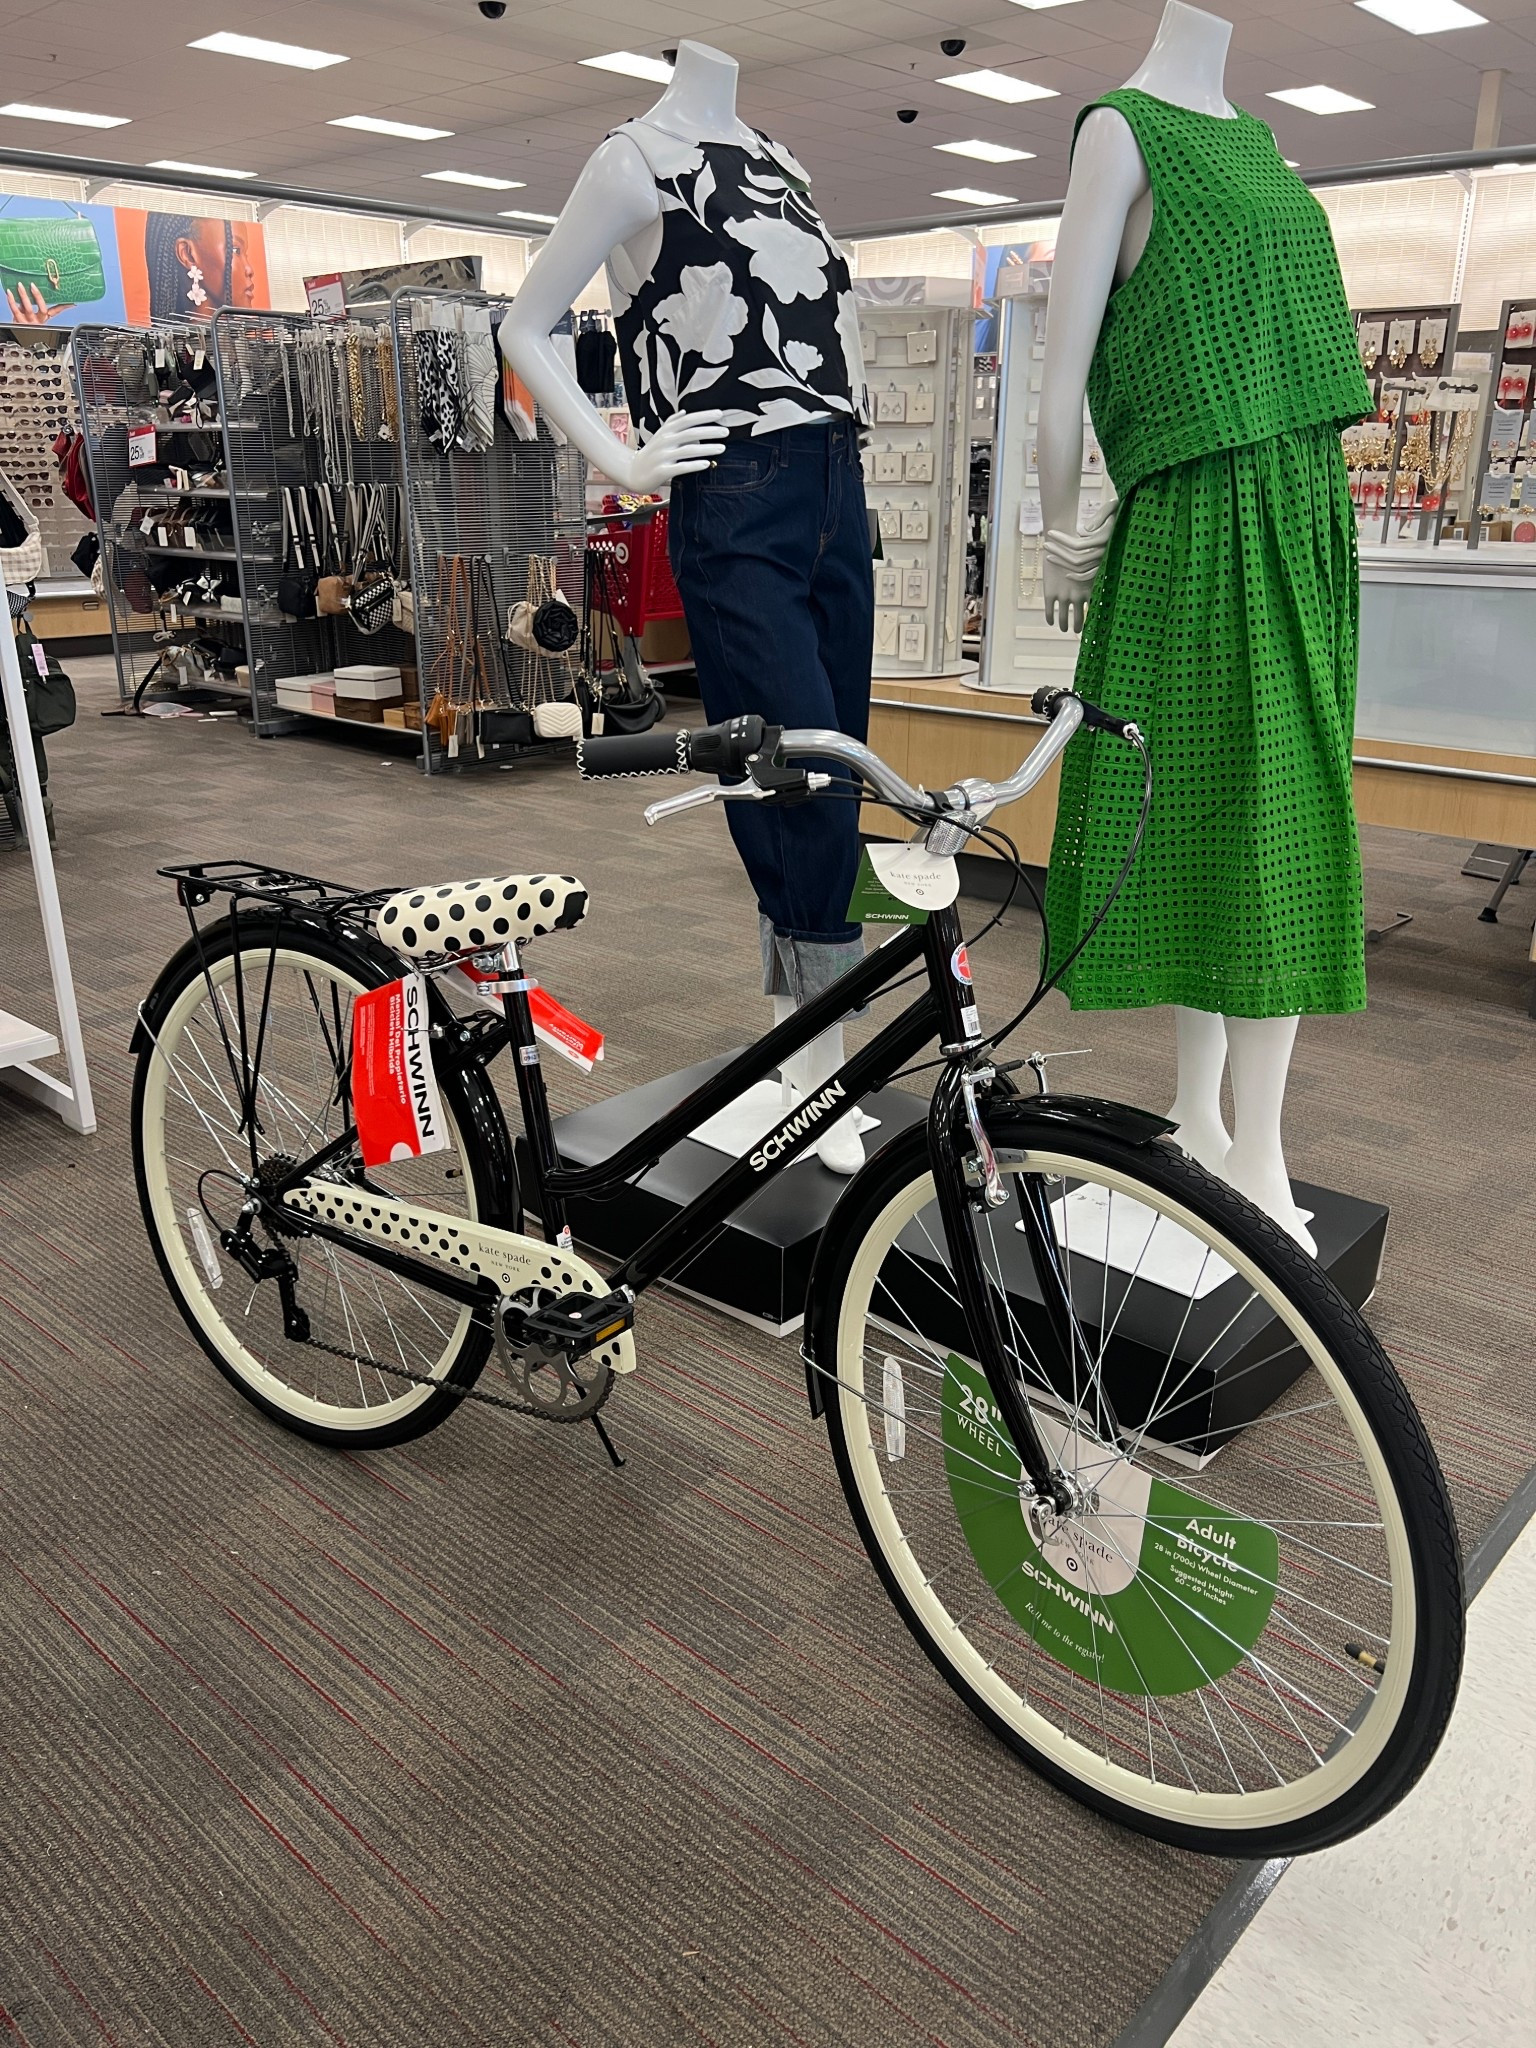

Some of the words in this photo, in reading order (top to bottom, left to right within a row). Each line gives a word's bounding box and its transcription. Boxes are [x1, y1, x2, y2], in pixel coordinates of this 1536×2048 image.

[130, 446, 140, 461] 25
[890, 871, 911, 880] kate
[913, 872, 941, 882] spade
[388, 995, 396, 1037] Bicicleta
[394, 1049, 407, 1105] Propietario
[406, 985, 435, 1138] SCHWINN
[749, 1079, 847, 1172] SCHWINN
[478, 1242, 500, 1257] kate
[502, 1251, 532, 1266] spade
[490, 1260, 503, 1268] NEW
[505, 1263, 521, 1273] YORK
[957, 1414, 1002, 1458] WHEEL
[1073, 1532, 1113, 1563] spade
[1185, 1518, 1237, 1550] Adult
[1154, 1542, 1164, 1552] 28
[1164, 1547, 1172, 1557] in
[1173, 1552, 1196, 1569] (700c)
[1198, 1563, 1222, 1580] Wheel
[1223, 1575, 1259, 1596] Diameter
[1176, 1533, 1239, 1573] Bicycle
[1021, 1560, 1114, 1635] SCHWINN
[1170, 1564, 1207, 1588] Suggested
[1208, 1583, 1235, 1600] Height:
[1174, 1576, 1185, 1586] 60
[1191, 1584, 1202, 1593] 69
[1203, 1589, 1227, 1606] Inches
[1041, 1619, 1053, 1631] me
[1053, 1628, 1061, 1638] to
[1062, 1634, 1074, 1647] the
